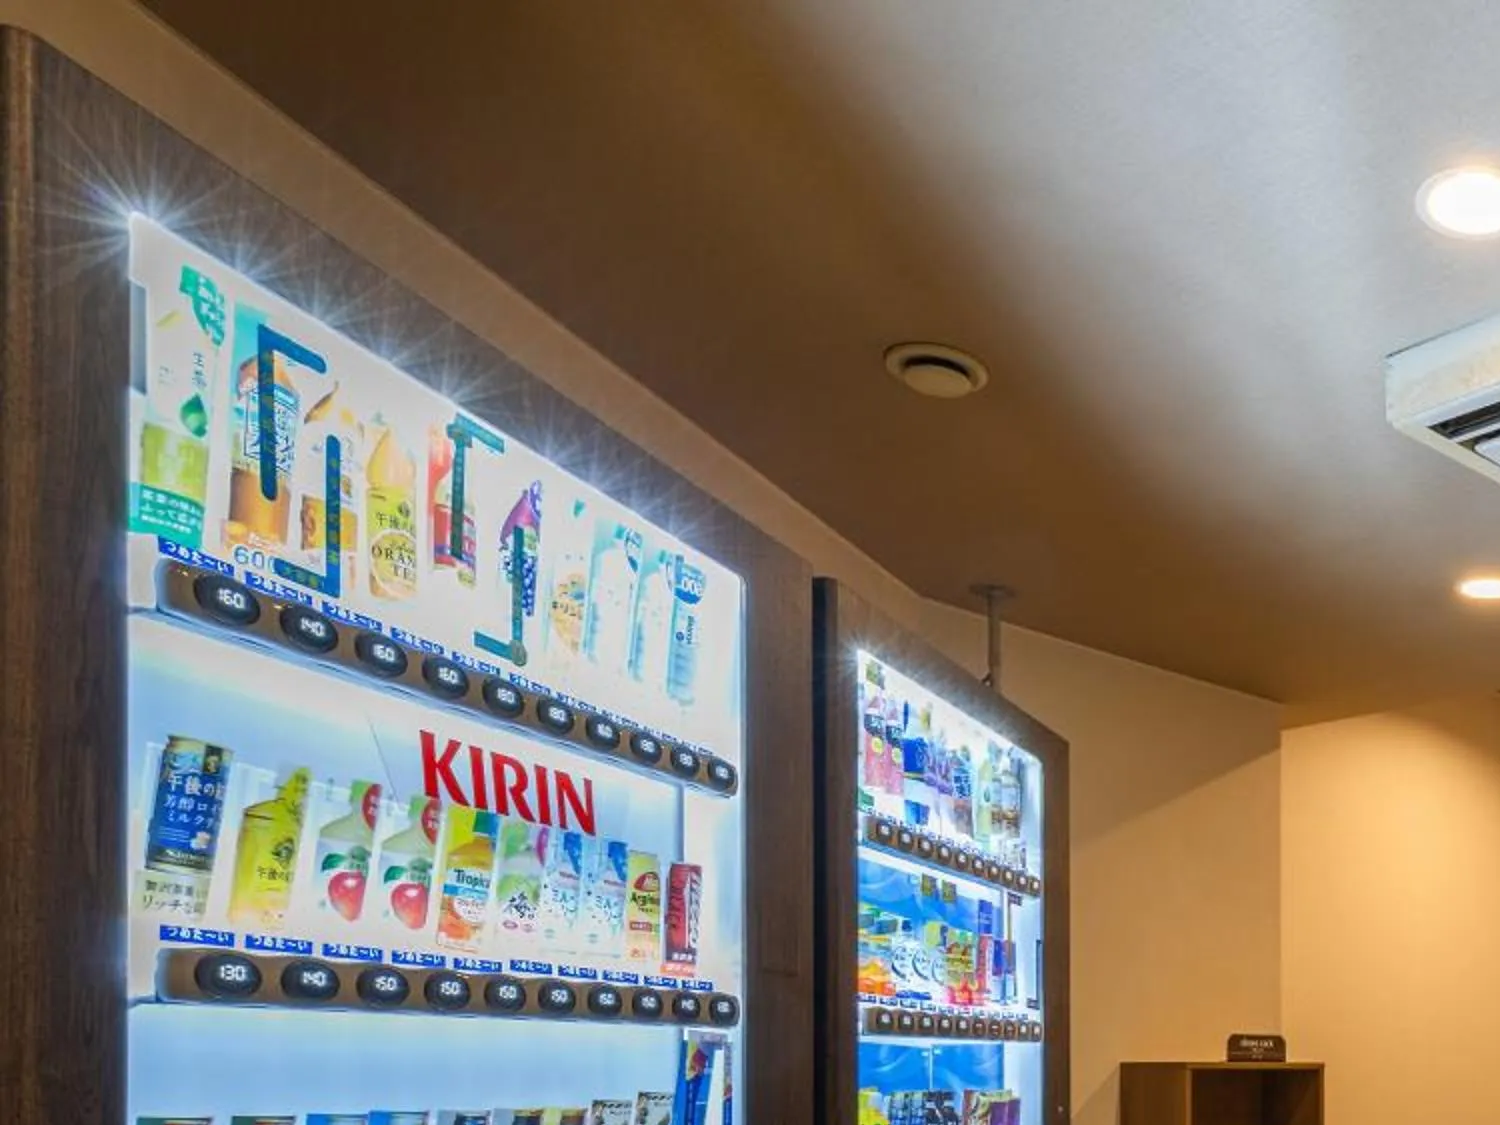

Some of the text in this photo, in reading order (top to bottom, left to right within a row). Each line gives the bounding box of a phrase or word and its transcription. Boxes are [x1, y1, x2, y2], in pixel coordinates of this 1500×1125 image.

[420, 729, 596, 836] KIRIN
[168, 927, 230, 945] つめた〜い
[253, 936, 309, 952] つめた〜い
[328, 944, 380, 959] つめた〜い
[219, 964, 246, 981] 130
